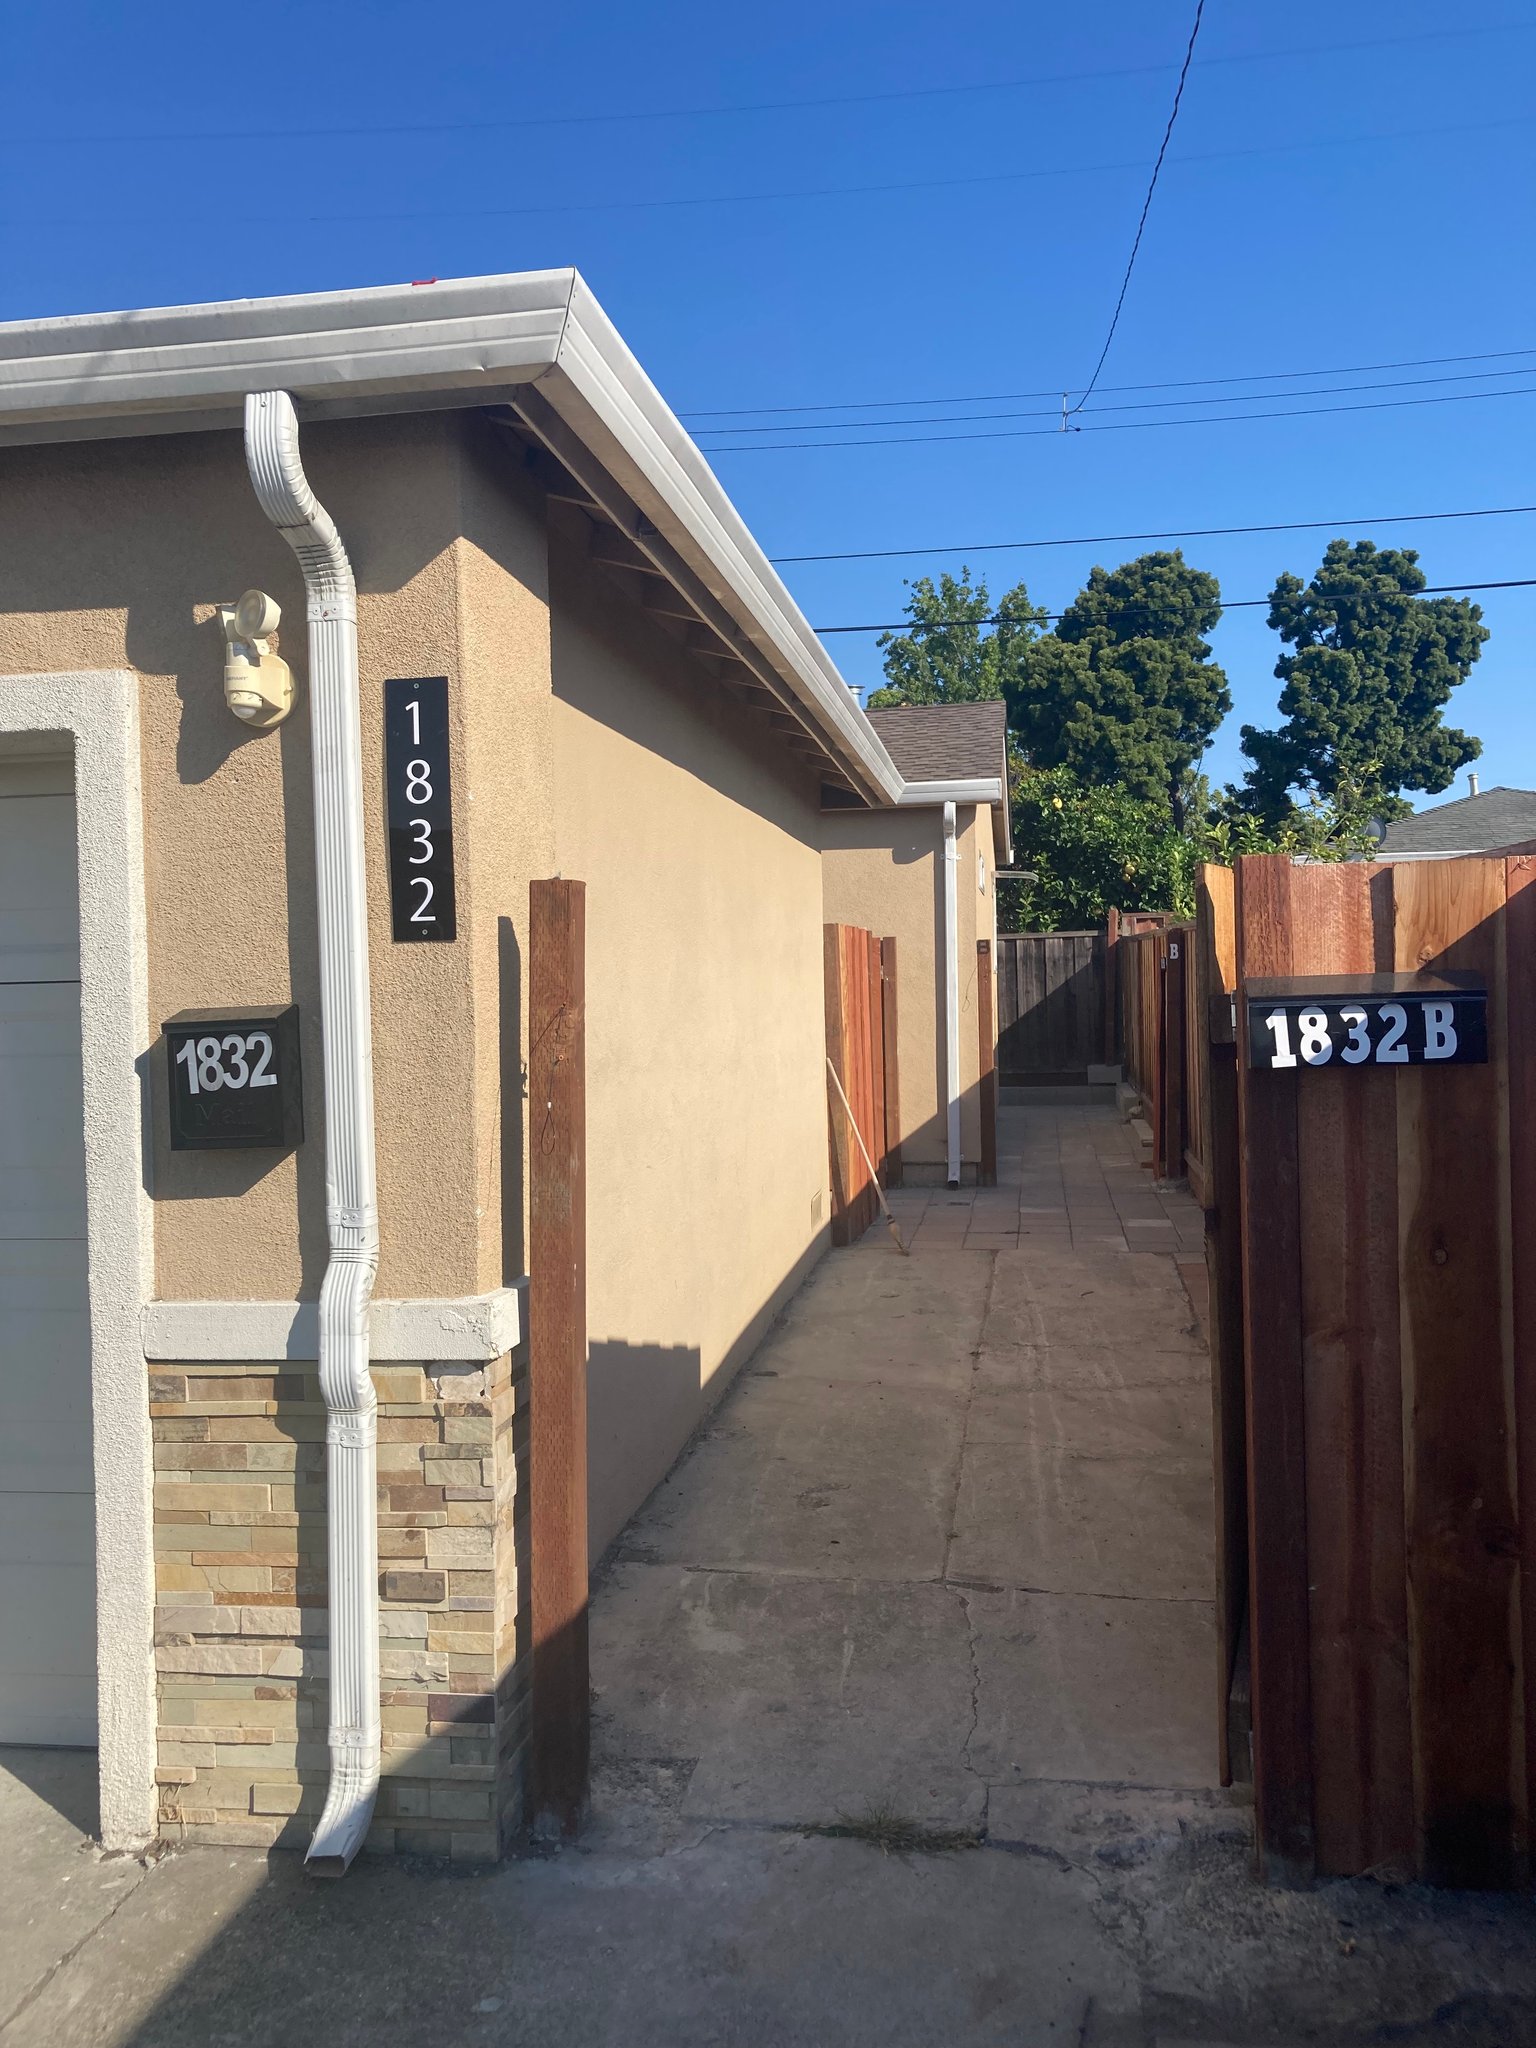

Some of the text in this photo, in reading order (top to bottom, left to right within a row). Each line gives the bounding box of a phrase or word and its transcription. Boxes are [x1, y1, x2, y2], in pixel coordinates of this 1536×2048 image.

[405, 701, 437, 922] 1832
[1170, 943, 1179, 959] B
[176, 1031, 278, 1095] 1832
[1265, 1001, 1458, 1069] 1832 B
